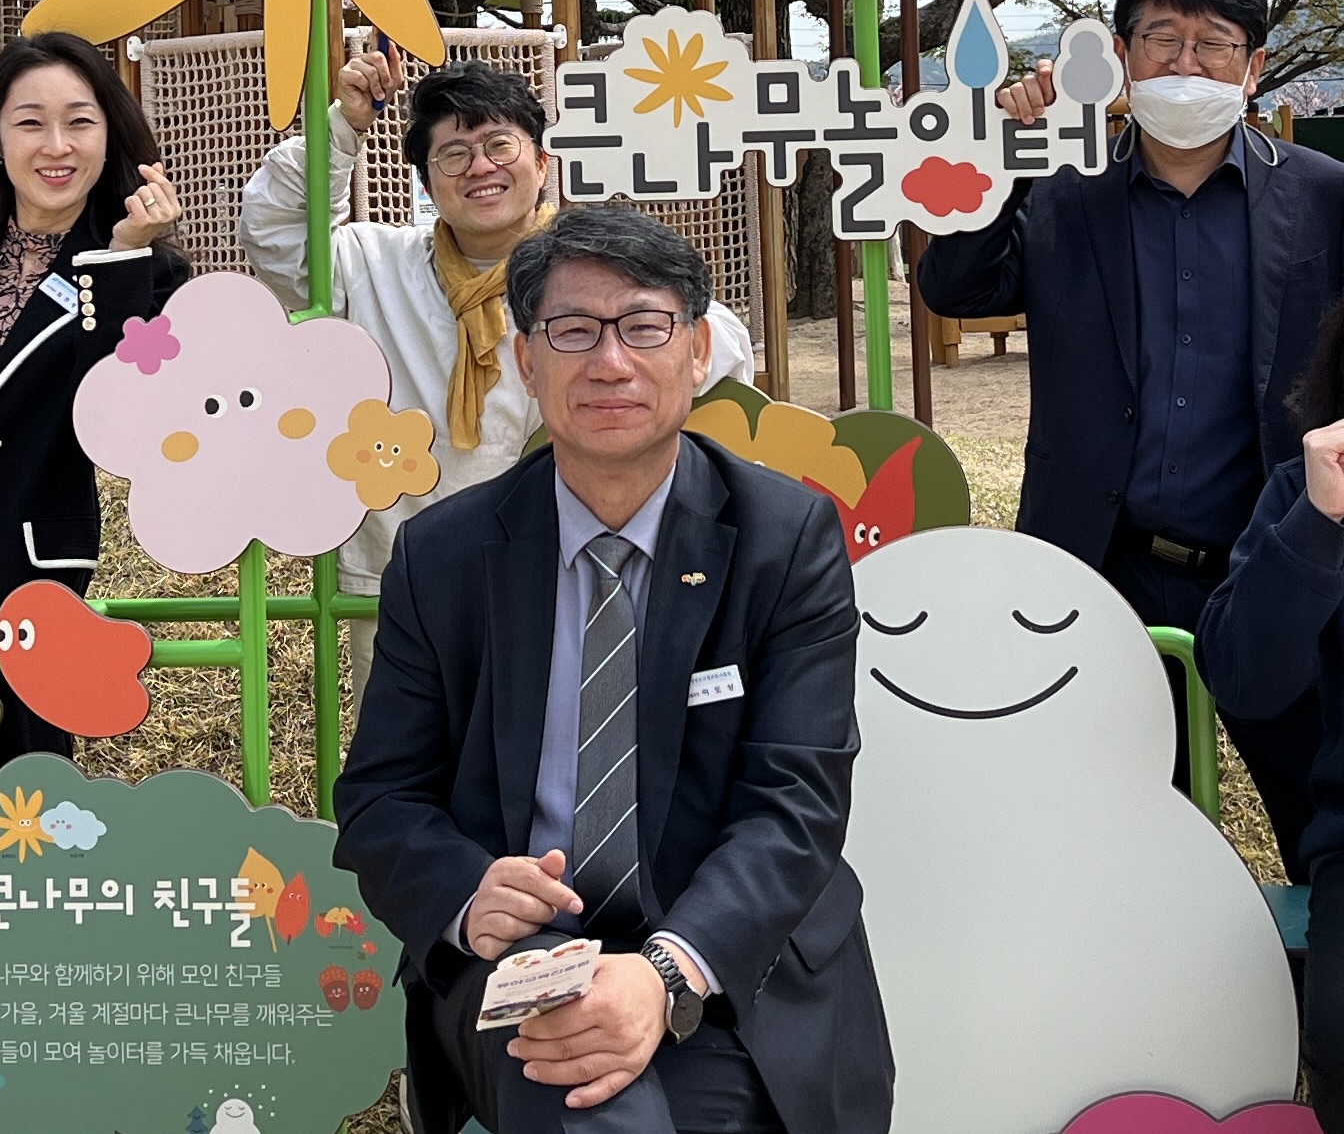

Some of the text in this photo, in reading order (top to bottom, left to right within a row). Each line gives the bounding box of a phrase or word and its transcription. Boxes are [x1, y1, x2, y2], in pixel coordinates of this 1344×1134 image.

[549, 69, 1099, 234] 큰나무놀이터
[153, 877, 257, 948] 친구들
[54, 962, 131, 987] 함께하기
[136, 962, 175, 987] 위해
[180, 963, 219, 987] 모인
[224, 963, 283, 988] 친구들
[0, 1001, 43, 1026] 가을,
[48, 1001, 87, 1026] 겨울
[91, 1001, 169, 1026] 계절마다
[174, 1002, 252, 1027] 큰나무를
[255, 1002, 335, 1027] 깨워주는
[43, 1040, 82, 1064] 모여
[86, 1040, 165, 1065] 놀이터를
[169, 1041, 209, 1065] 가득
[213, 1041, 296, 1066] 채웁니다.
